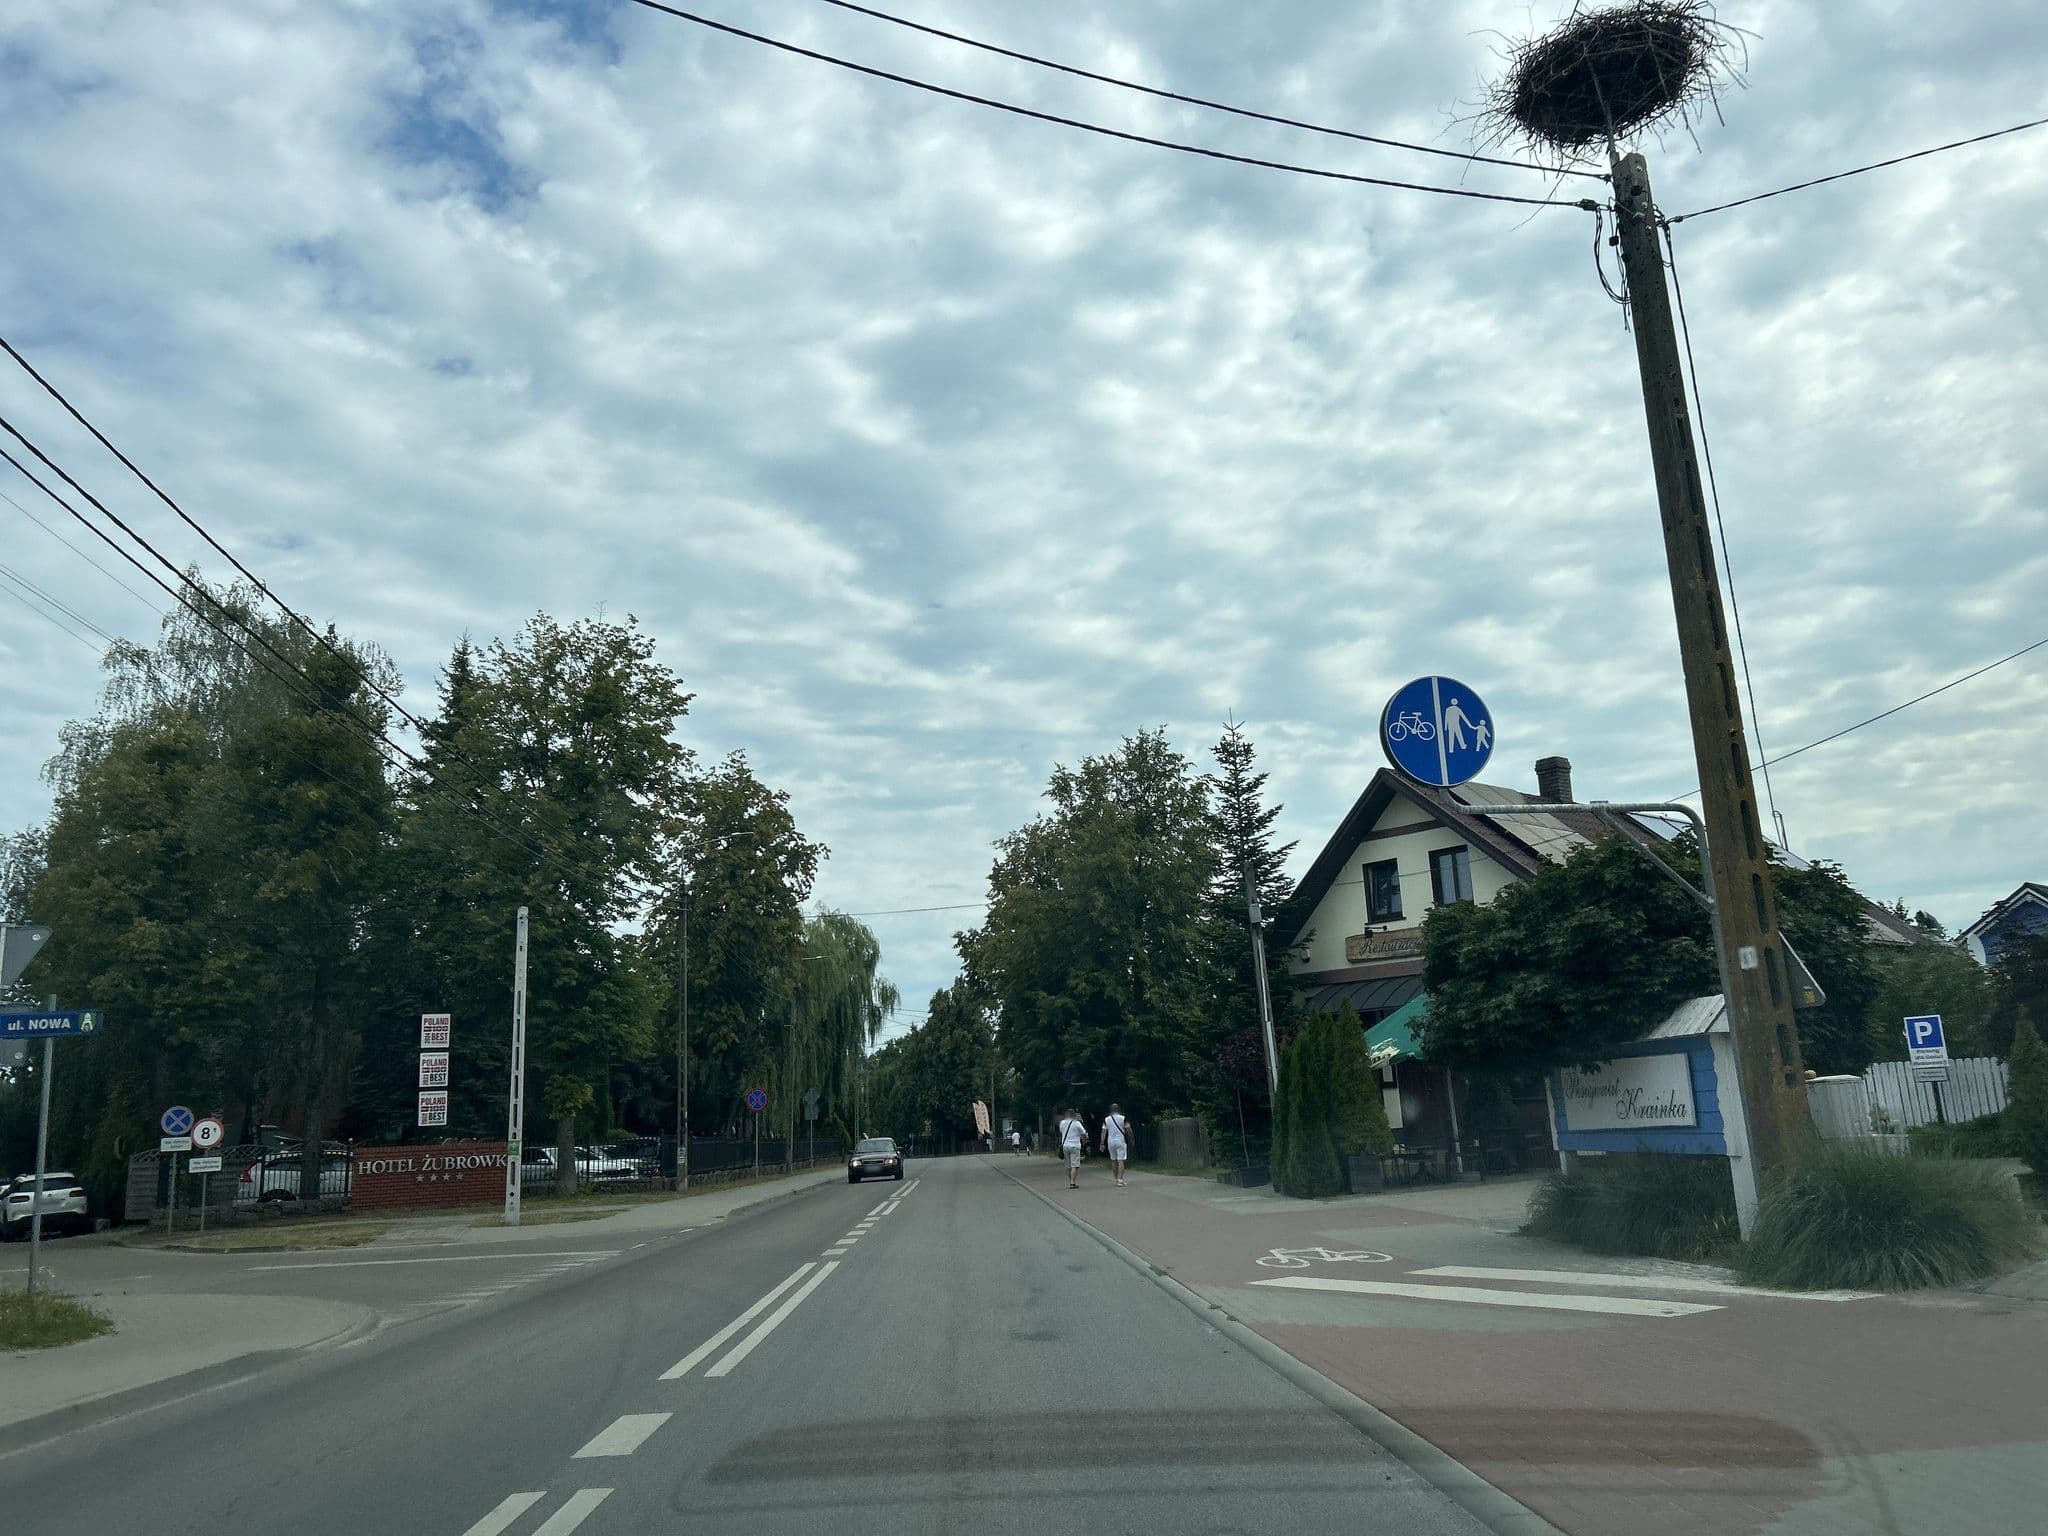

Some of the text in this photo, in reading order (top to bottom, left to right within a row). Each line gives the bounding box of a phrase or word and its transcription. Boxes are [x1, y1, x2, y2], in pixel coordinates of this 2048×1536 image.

[7, 1018, 71, 1031] ul. NOWA
[424, 1017, 449, 1026] POLAND
[431, 1033, 448, 1041] BEST
[1914, 1021, 1933, 1045] P
[421, 1058, 447, 1067] POLAND
[430, 1073, 446, 1081] BEST
[421, 1096, 446, 1106] POLAND
[1616, 1087, 1686, 1120] Krainka
[429, 1112, 445, 1121] BEST
[358, 1153, 508, 1175] HOTEL ŻUBRÓWK
